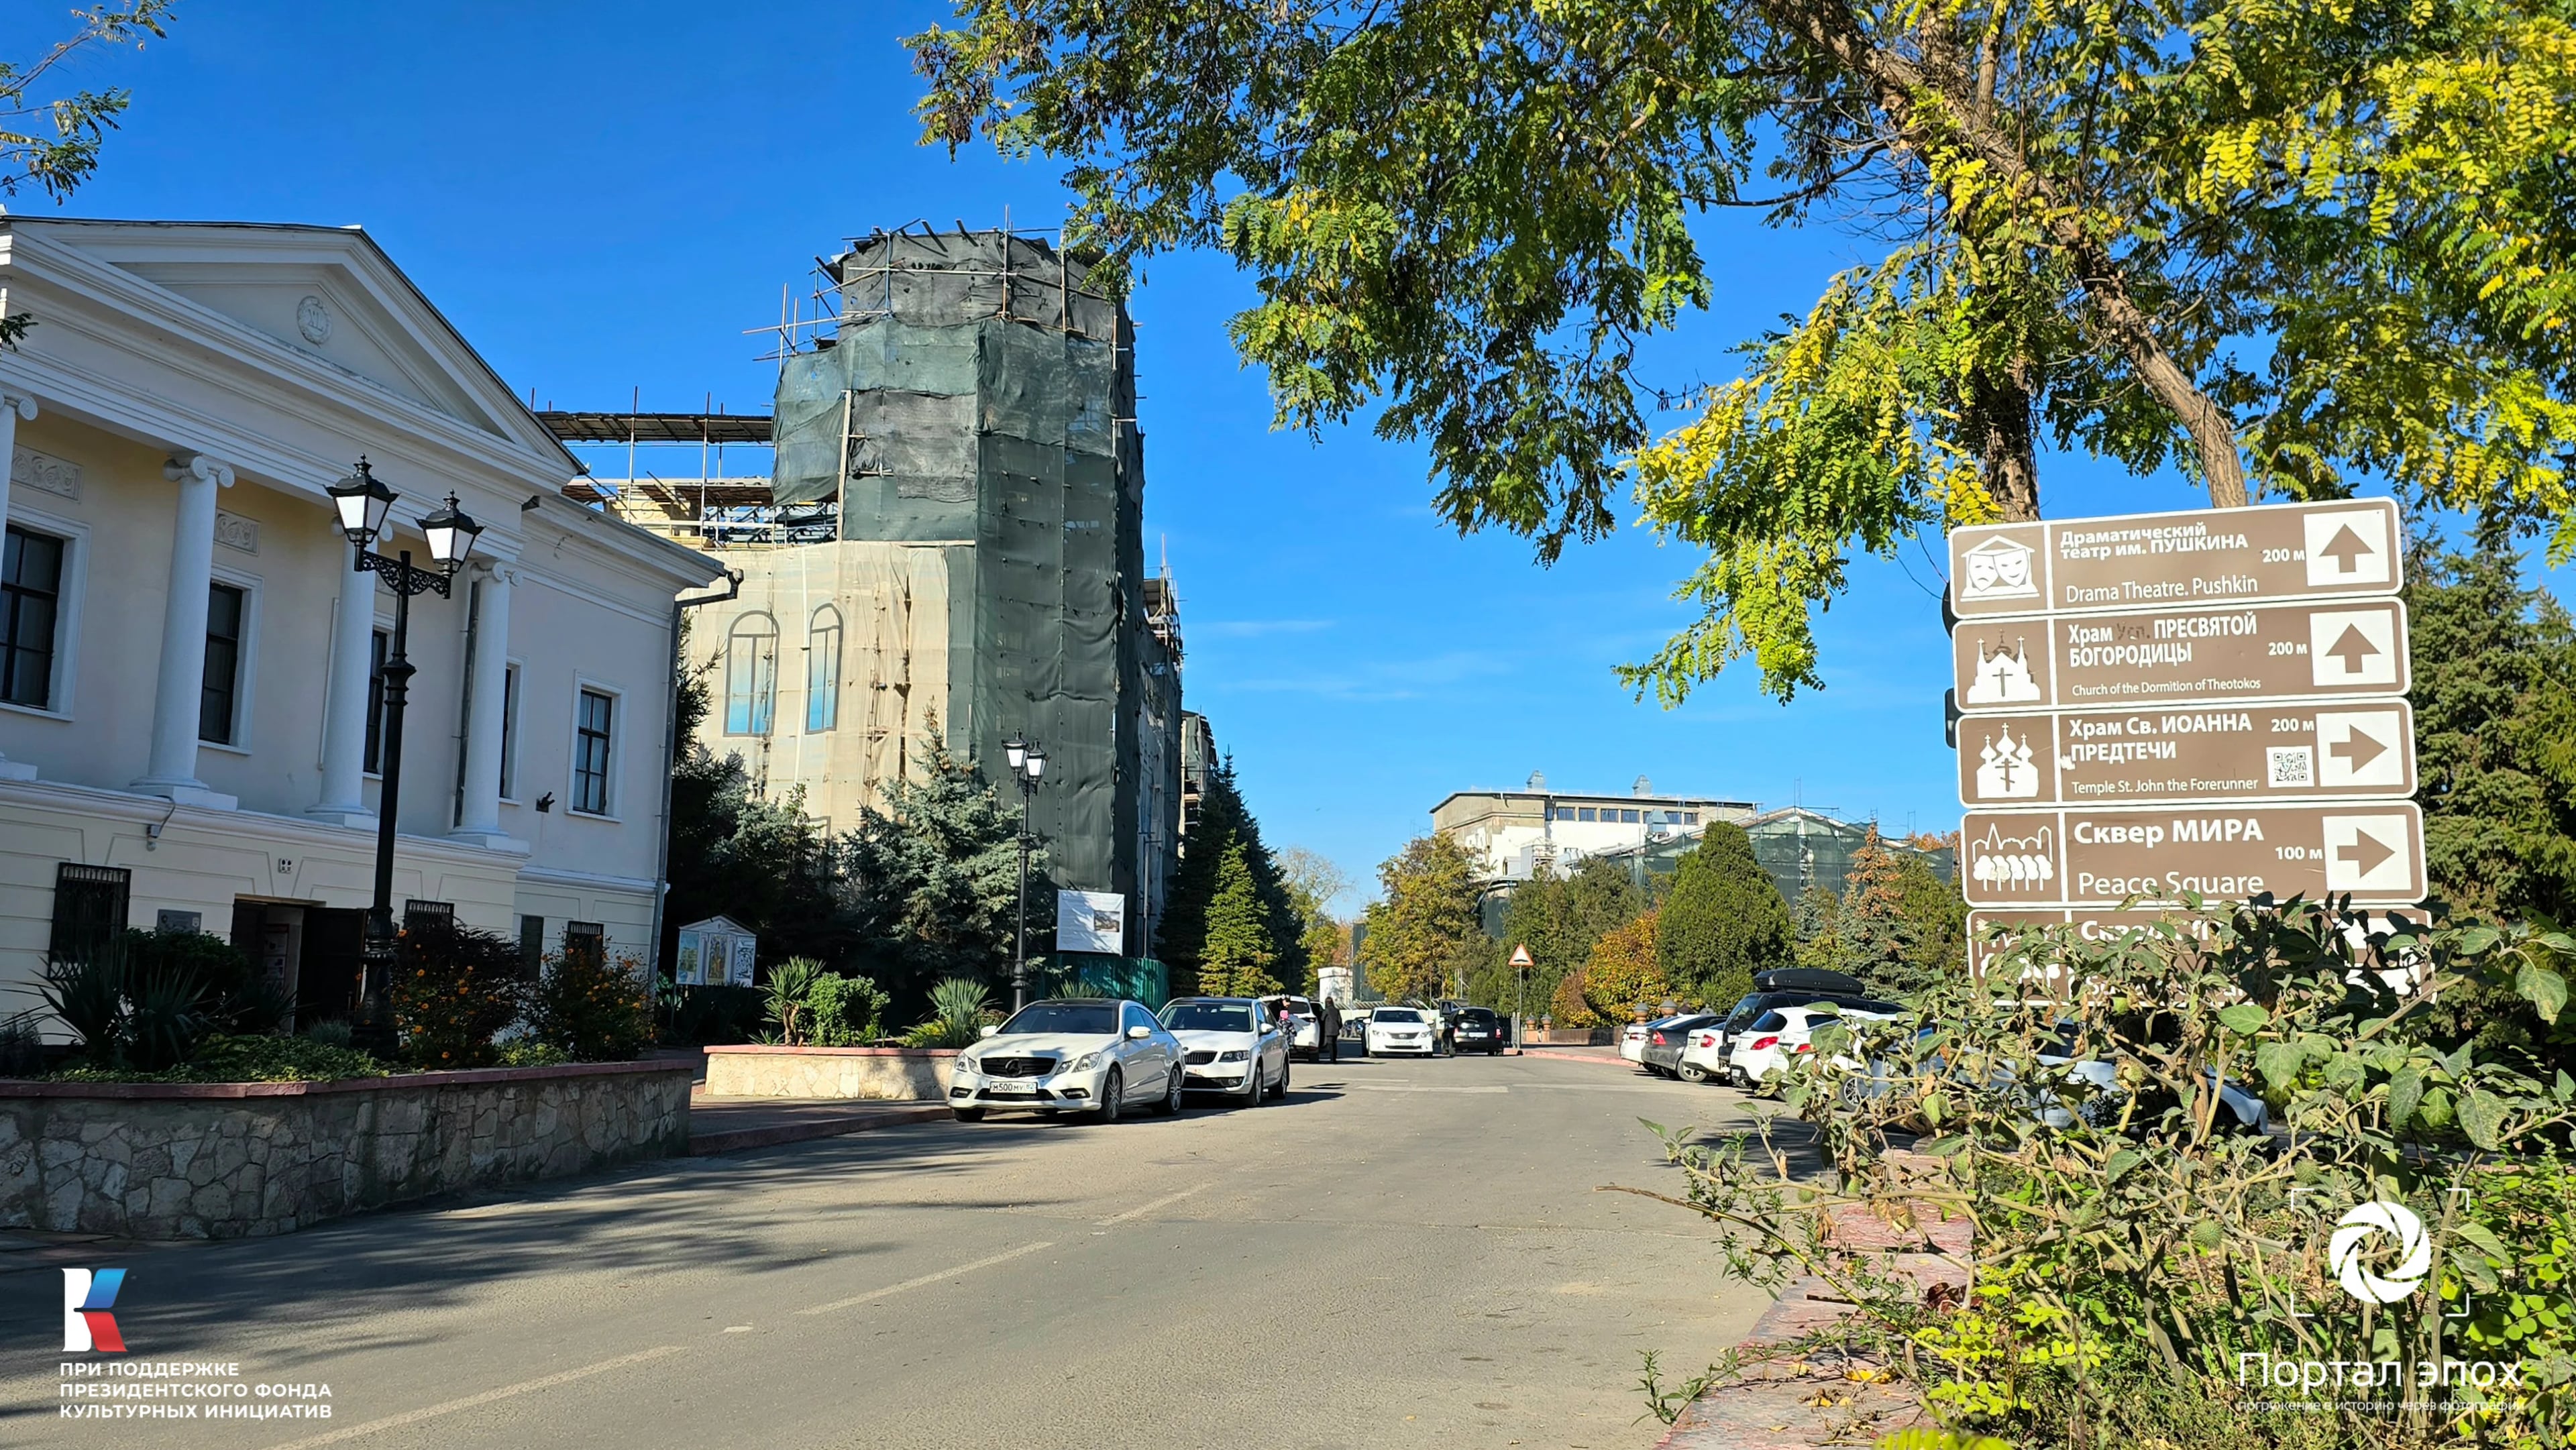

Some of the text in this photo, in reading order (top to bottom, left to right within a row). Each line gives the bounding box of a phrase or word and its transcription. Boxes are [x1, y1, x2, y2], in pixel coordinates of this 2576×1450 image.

[2060, 521, 2207, 548] Драматический
[2060, 534, 2249, 561] театр им. ПУШКИНА
[2261, 548, 2306, 563] 200 м
[2066, 575, 2259, 603] Drama Theatre. Pushkin
[2068, 624, 2113, 648] Храм
[2154, 610, 2257, 639] ПРЕСВЯТОЙ
[2070, 642, 2192, 668] БОГОРОДИЦЫ
[2268, 641, 2308, 656] 200 м
[2072, 677, 2261, 697] Church of the Dormition of Theotokos
[2069, 713, 2253, 741] Храм Св. ИОАННА
[2271, 718, 2314, 732] 200 м
[2071, 741, 2177, 765] ПРЕДТЕЧИ
[2072, 778, 2259, 796] Temple St. John the Forerunner
[2074, 818, 2265, 848] Сквер МИРА
[2275, 846, 2323, 860] 100 м
[2079, 871, 2265, 896] Peace Square
